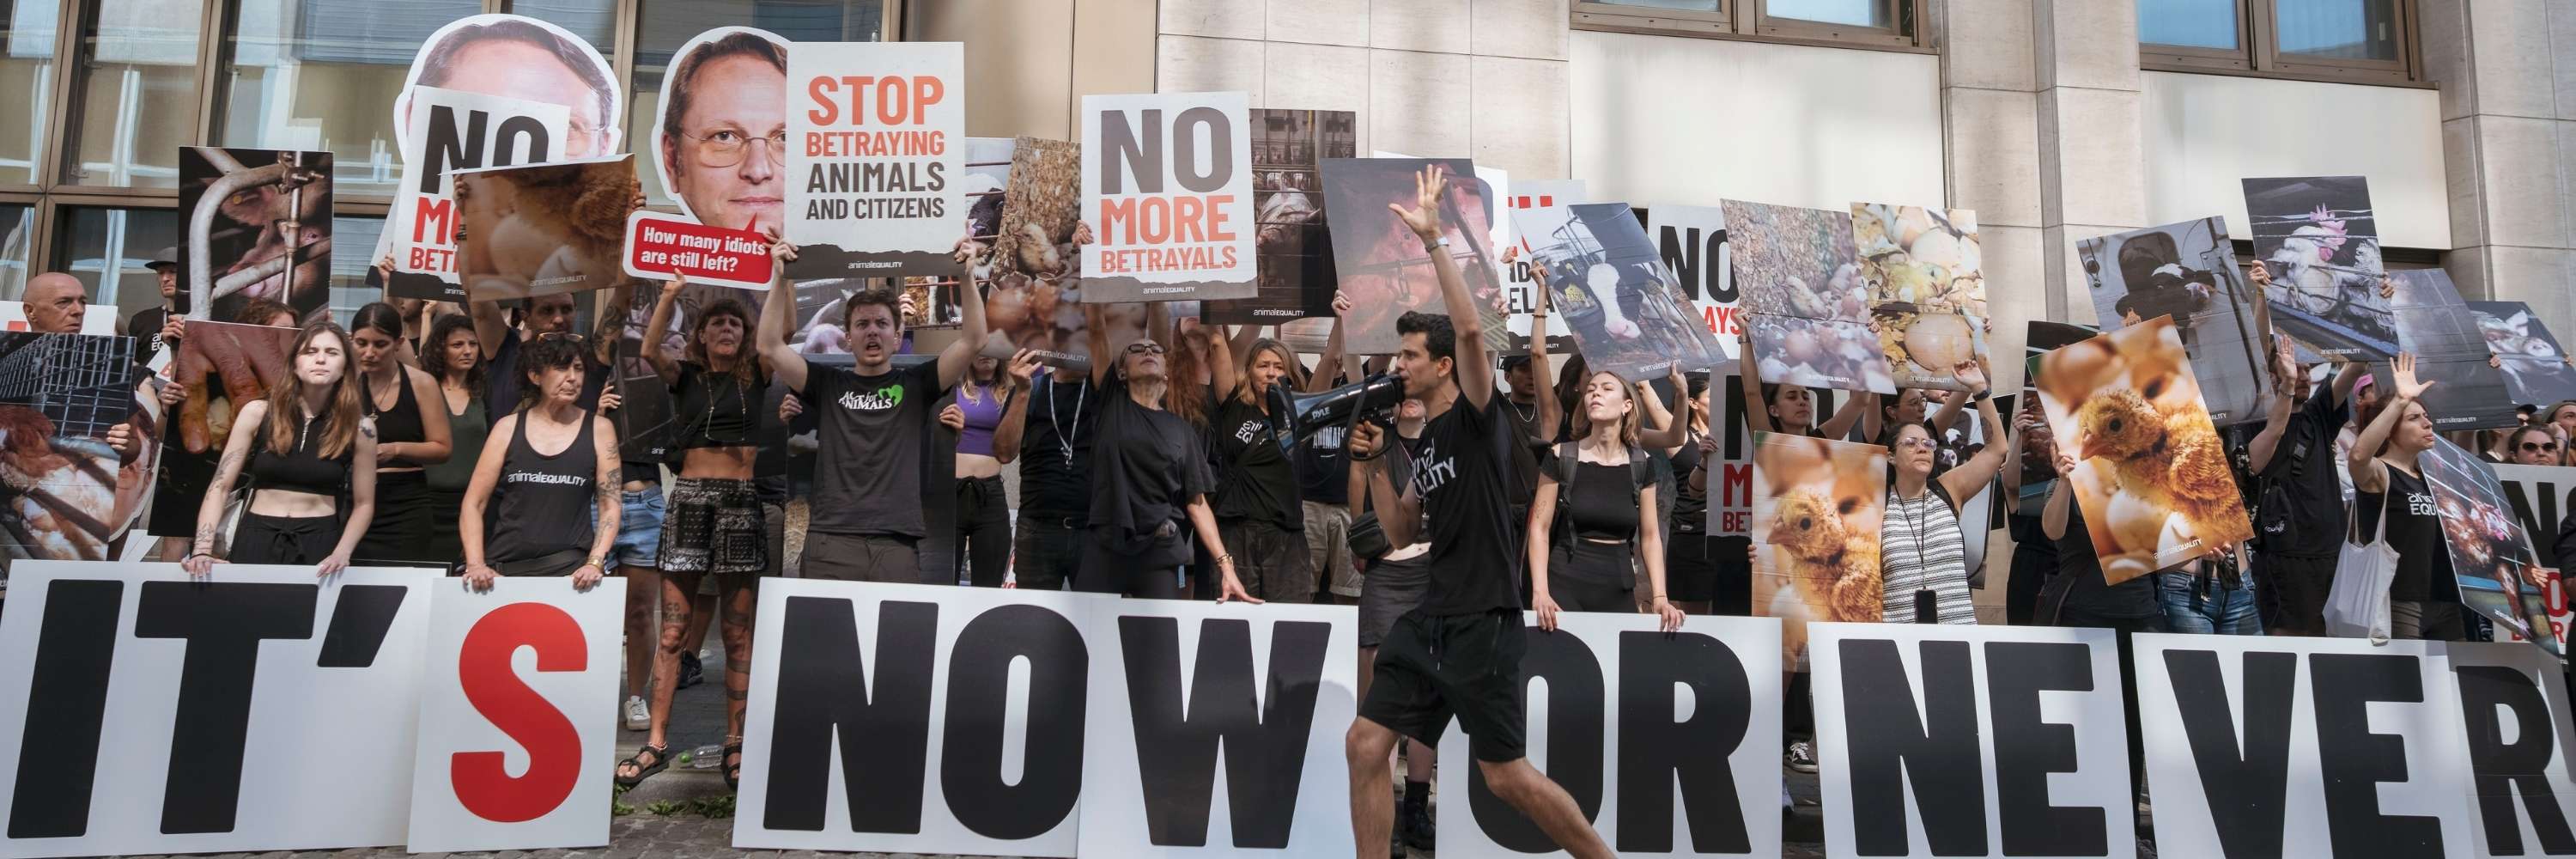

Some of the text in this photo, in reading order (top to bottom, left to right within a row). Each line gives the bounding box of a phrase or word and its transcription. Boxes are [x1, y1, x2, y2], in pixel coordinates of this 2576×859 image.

[808, 76, 944, 126] STOP
[806, 131, 945, 156] BETRAYING
[1101, 107, 1233, 195] NO
[806, 161, 945, 193] ANIMALS
[806, 198, 945, 220] AND CITIZENS
[1101, 195, 1236, 247] MORE
[643, 227, 766, 256] How many idiots
[641, 250, 738, 272] are still left?
[848, 260, 902, 269] animalEQUALITY
[1101, 245, 1237, 273] BETRAYALS
[1143, 286, 1195, 295] animalEQUALITY
[1254, 308, 1304, 317] animalEQUALITY
[508, 470, 586, 486] animalEQUALITY
[7, 579, 2576, 859] IT'S NOW OR NEVER
